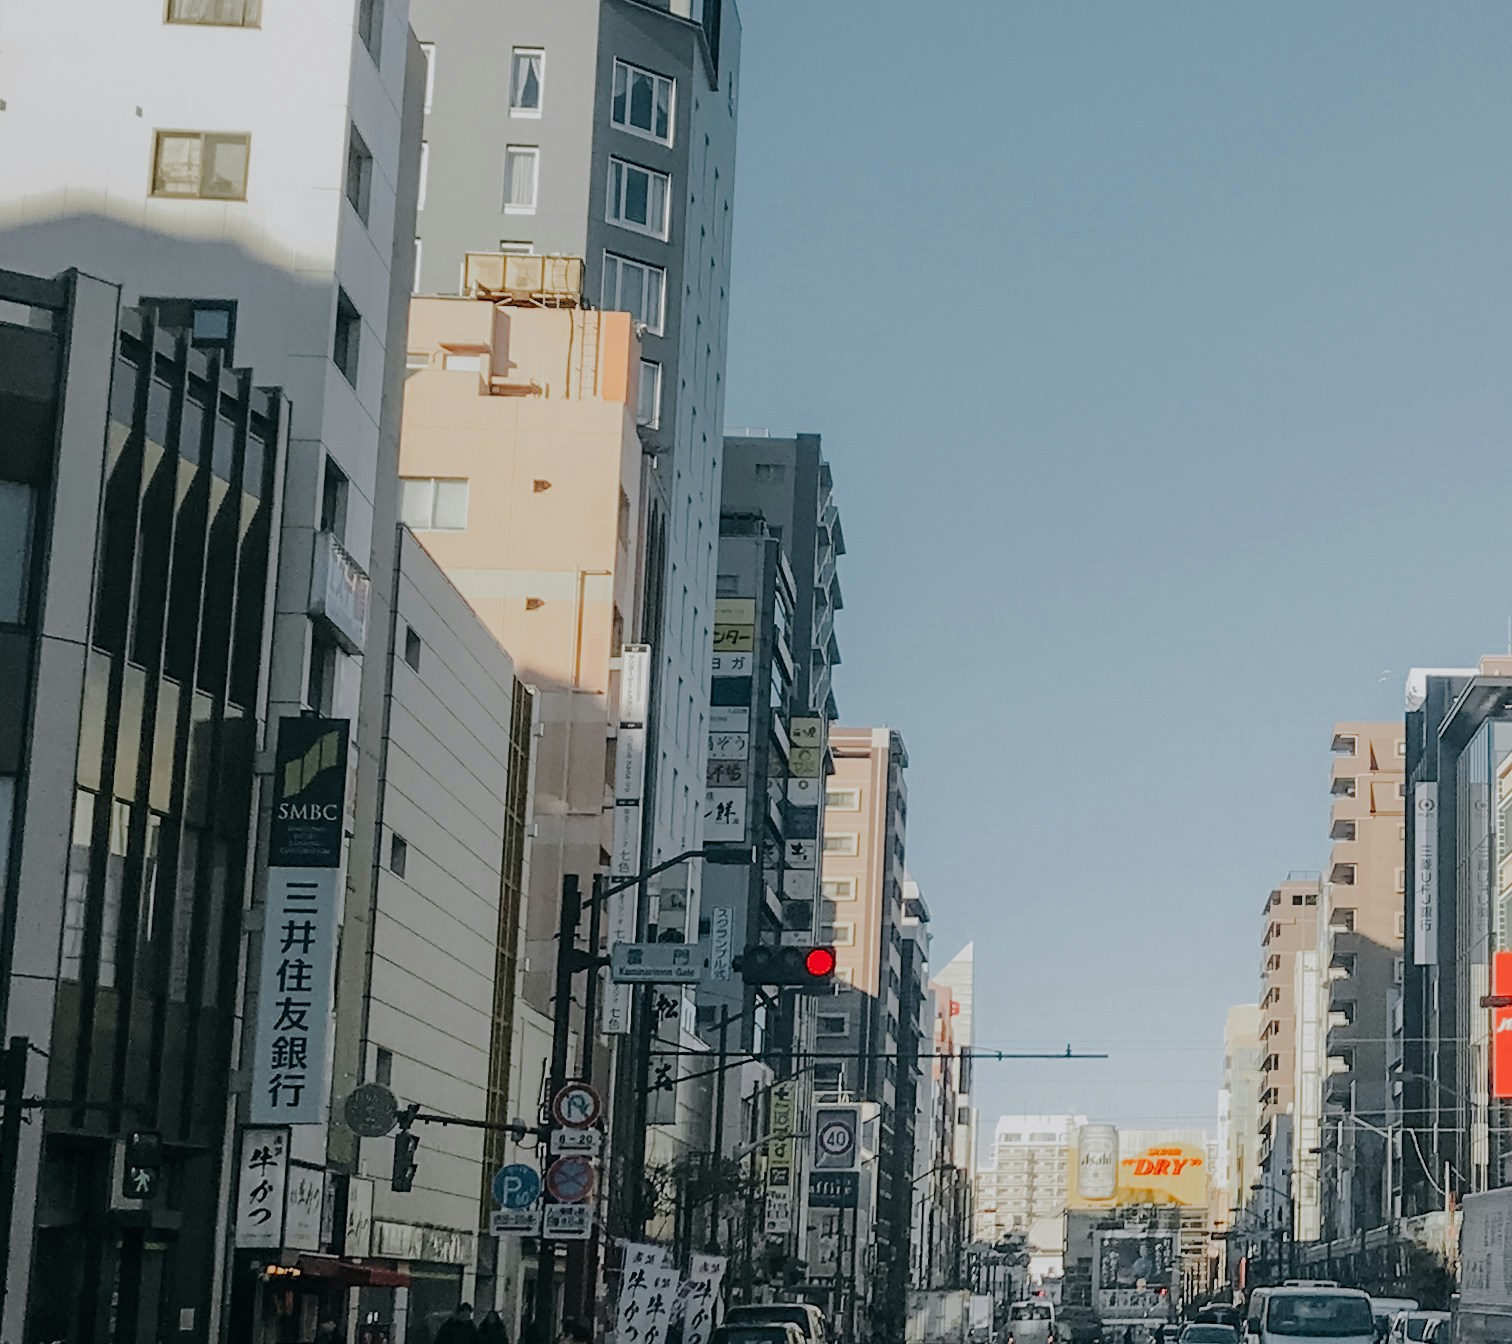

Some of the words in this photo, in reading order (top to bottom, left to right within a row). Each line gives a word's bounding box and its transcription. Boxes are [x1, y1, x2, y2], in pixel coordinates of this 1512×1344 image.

[278, 803, 338, 821] SMBC
[268, 882, 318, 1108] 三井住友銀行
[826, 1131, 846, 1147] 40
[248, 1145, 278, 1227] 牛かつ
[623, 1268, 648, 1343] 牛かつ
